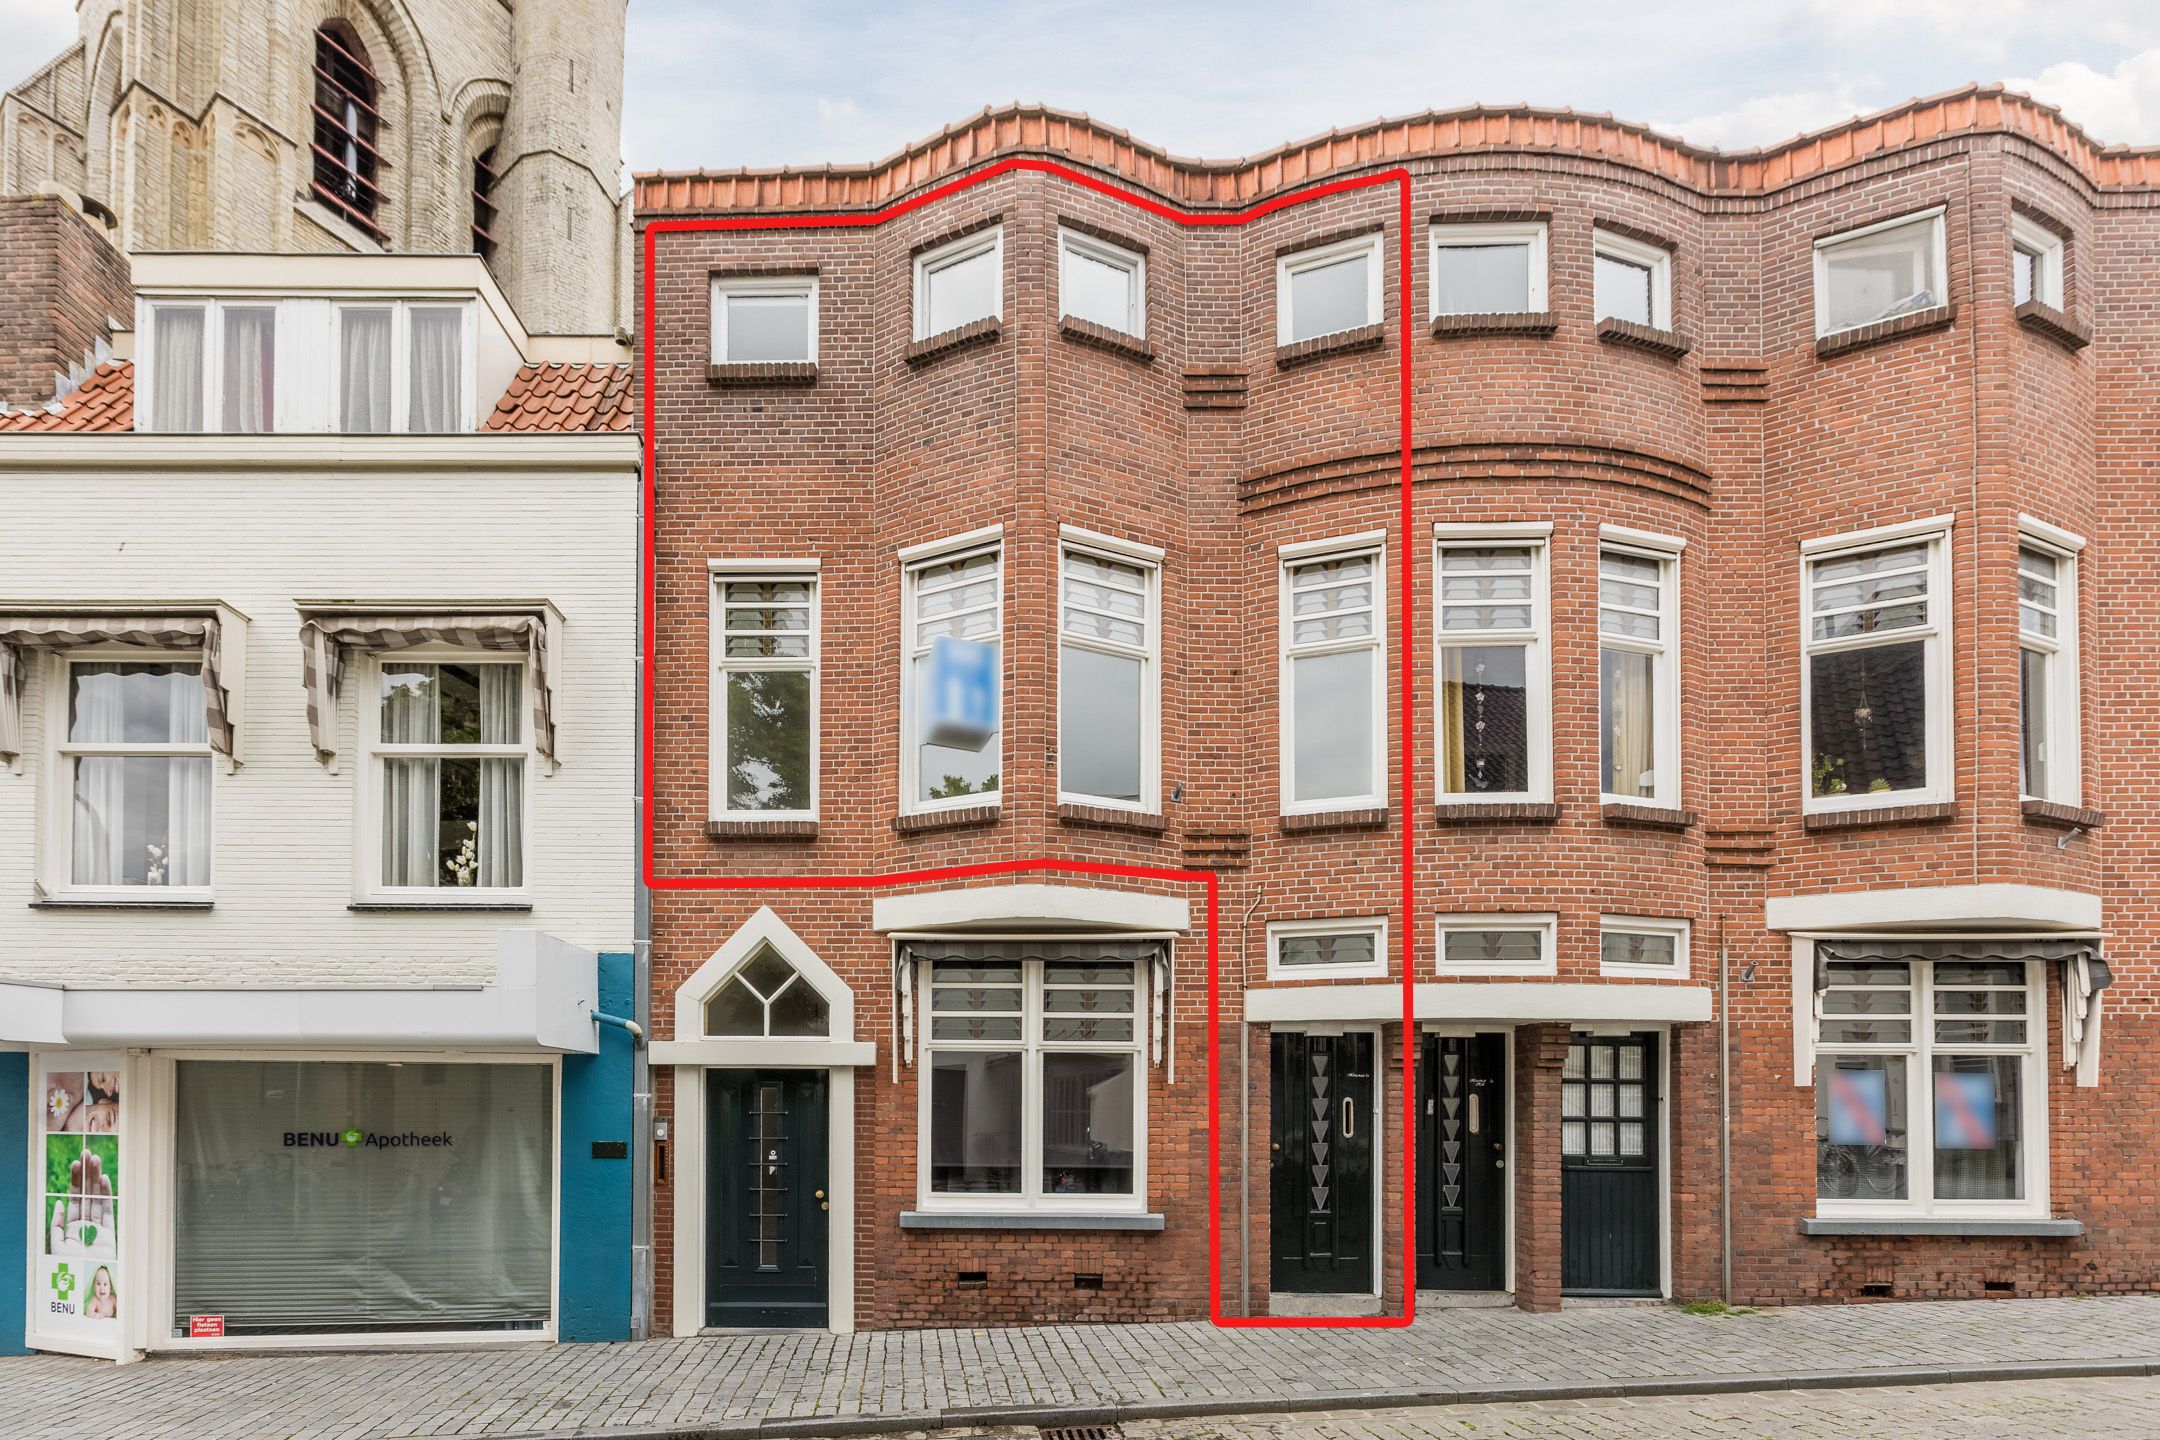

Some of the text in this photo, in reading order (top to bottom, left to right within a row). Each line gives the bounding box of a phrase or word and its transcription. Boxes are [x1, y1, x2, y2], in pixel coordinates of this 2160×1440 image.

[283, 1131, 453, 1149] BENU Apotheek
[50, 1301, 75, 1315] BENU
